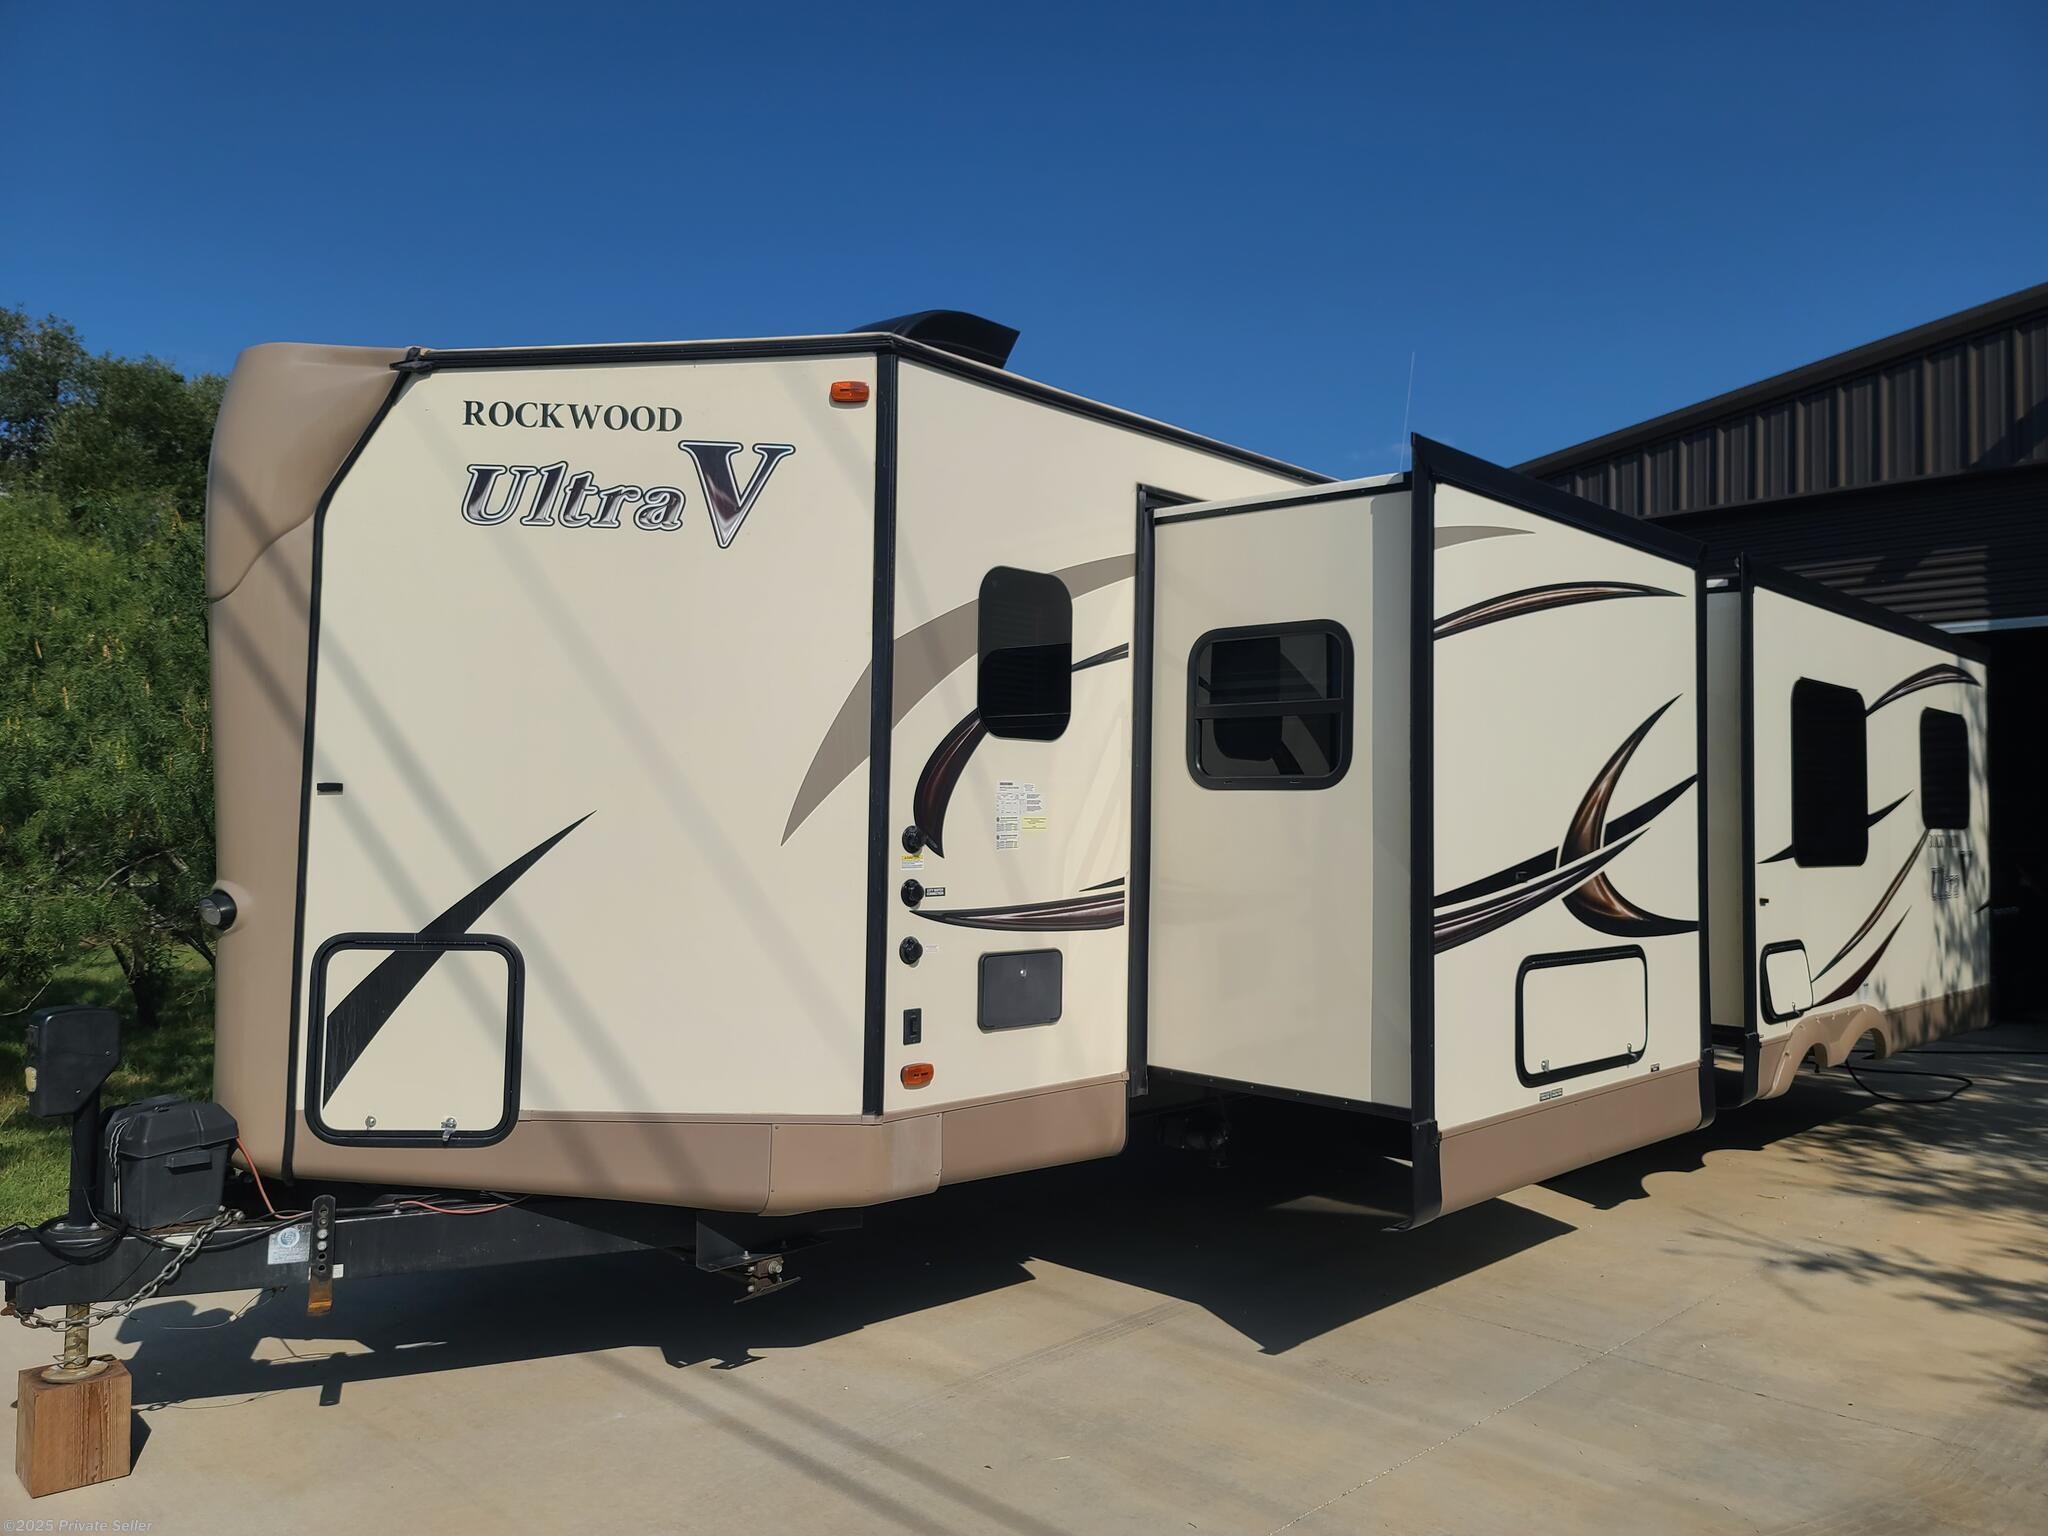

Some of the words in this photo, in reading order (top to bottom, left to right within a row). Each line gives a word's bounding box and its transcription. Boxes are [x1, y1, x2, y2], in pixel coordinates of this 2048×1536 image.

[463, 399, 683, 433] ROCKWOOD
[461, 460, 686, 532] Ultra
[677, 440, 796, 549] V
